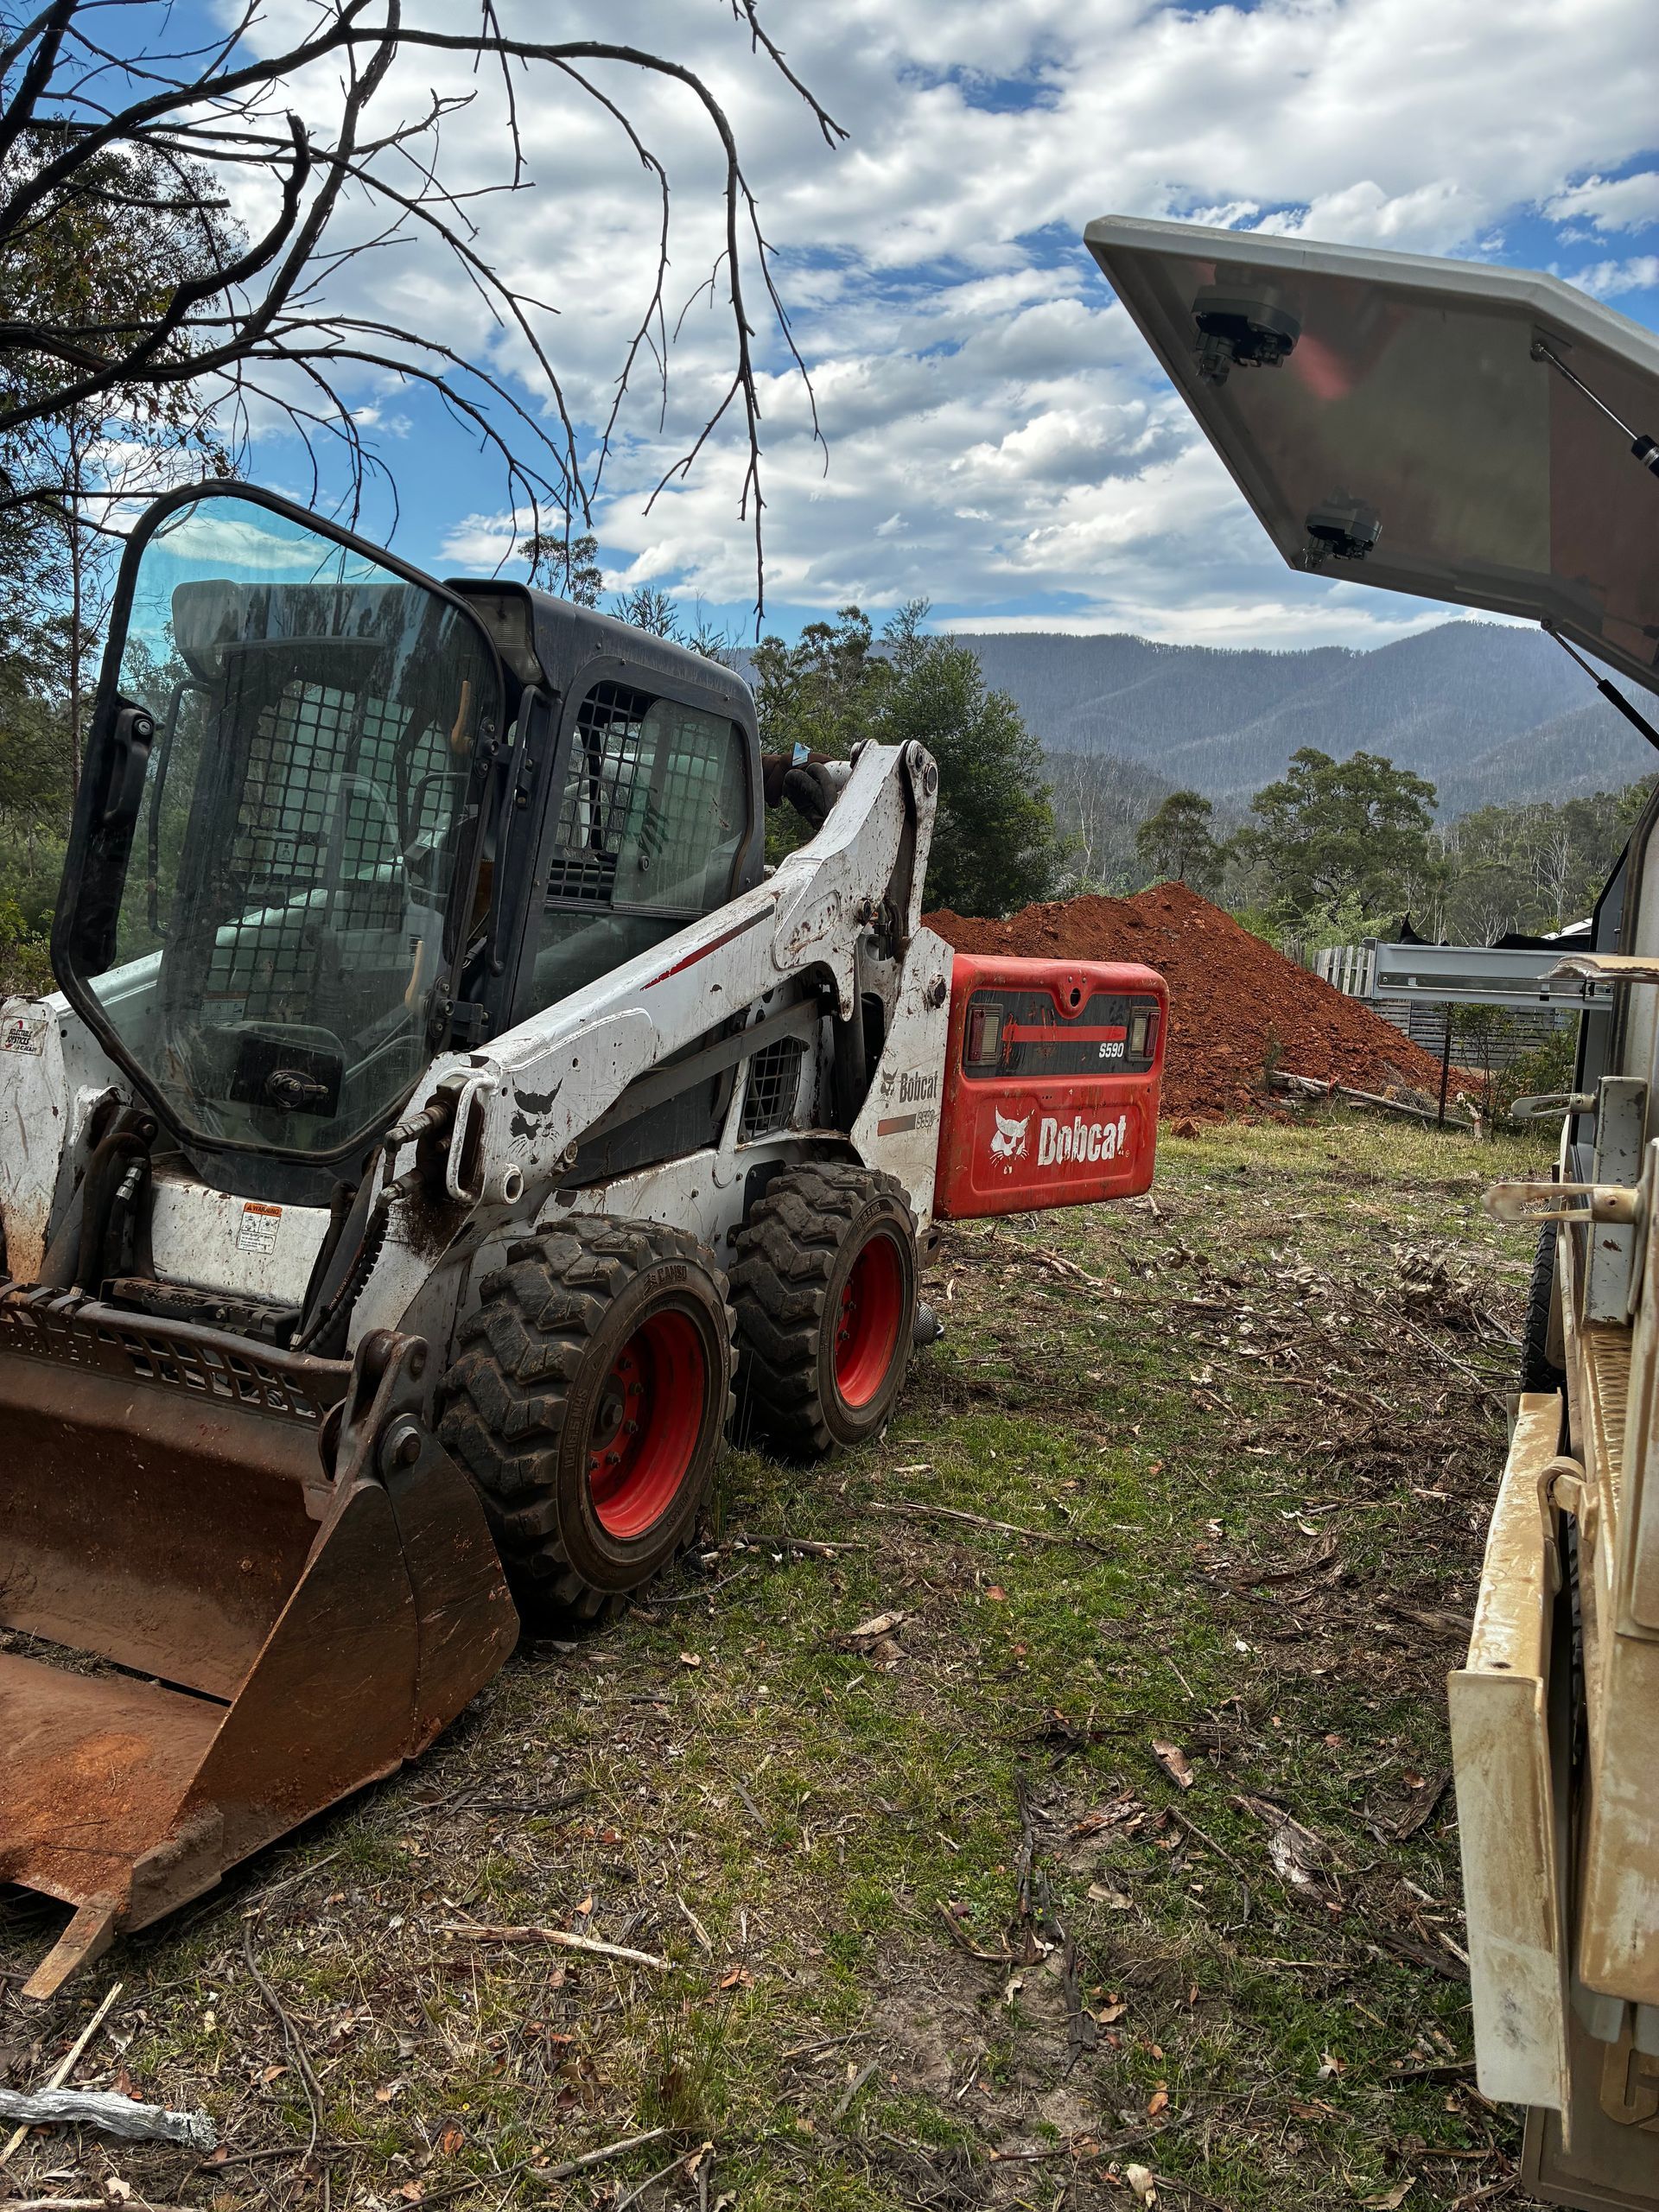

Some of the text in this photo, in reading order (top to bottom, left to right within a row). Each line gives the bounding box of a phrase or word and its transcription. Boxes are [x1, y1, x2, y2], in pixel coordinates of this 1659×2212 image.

[1098, 1042, 1124, 1058] S590
[899, 1071, 938, 1103] Bobcat
[1037, 1115, 1127, 1166] Bobcat
[252, 1205, 279, 1215] WARNING
